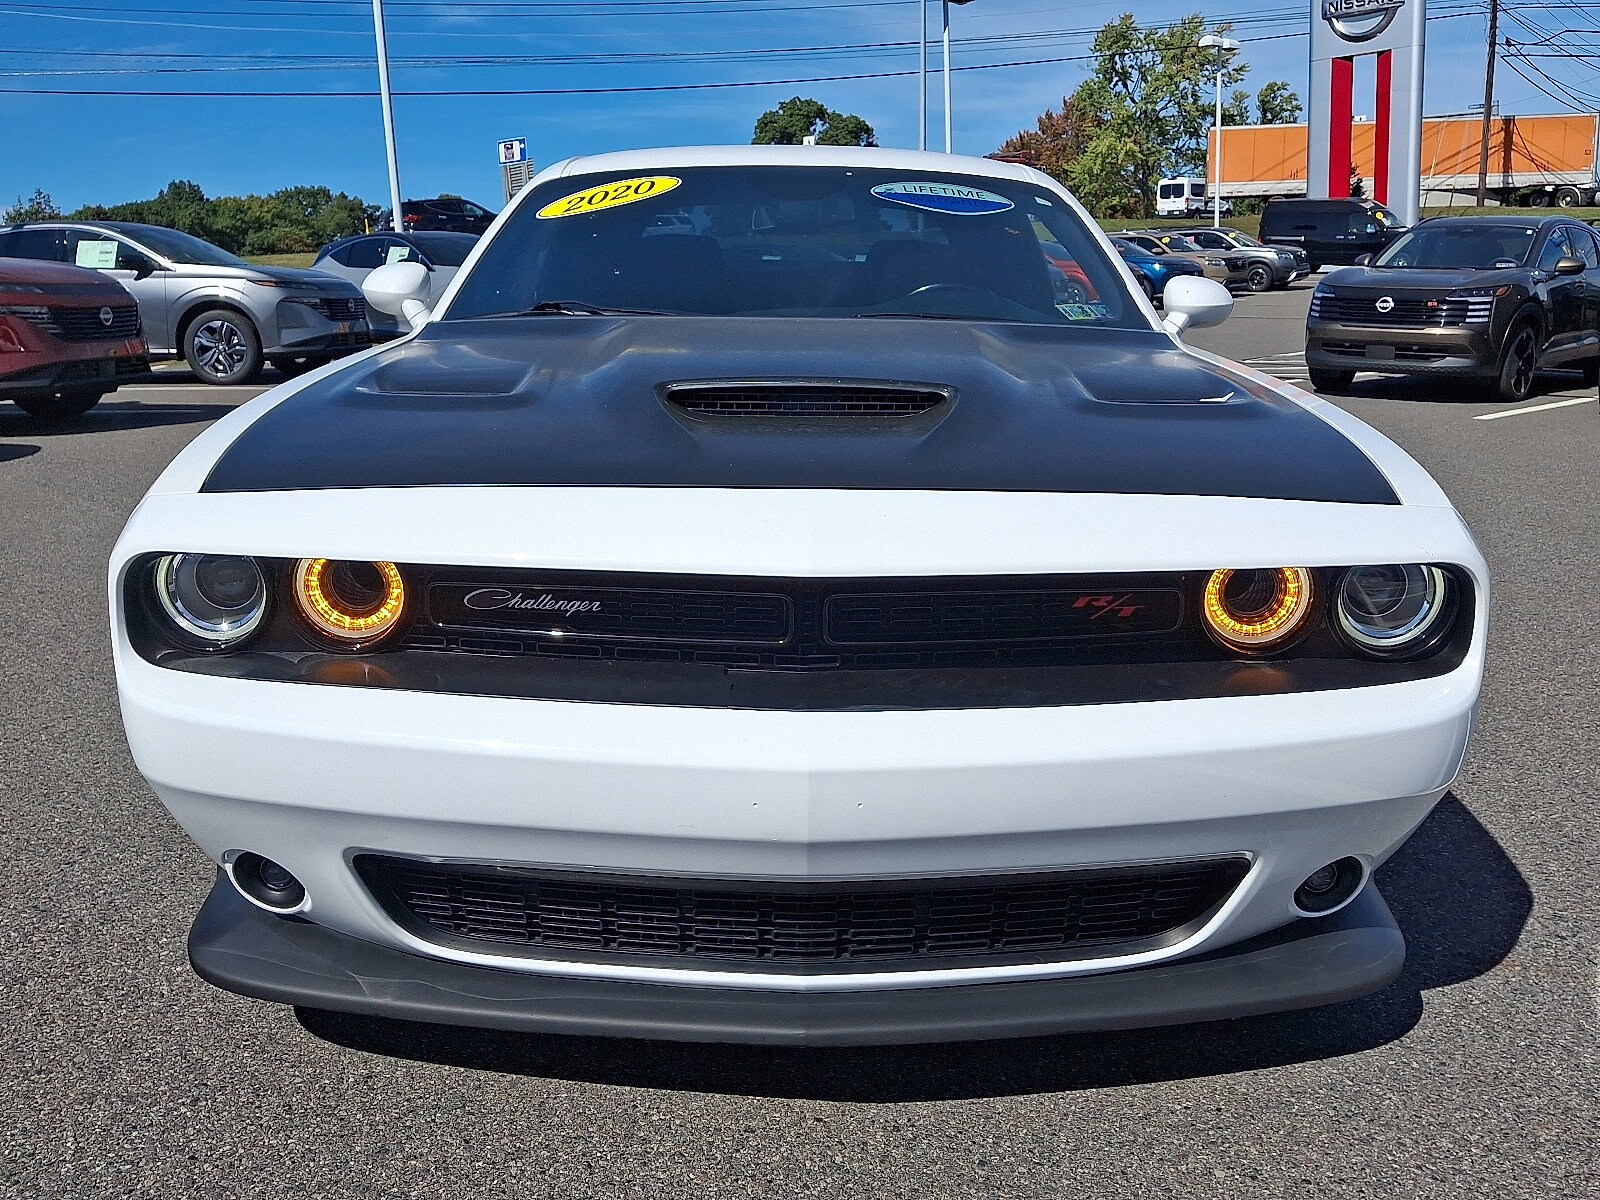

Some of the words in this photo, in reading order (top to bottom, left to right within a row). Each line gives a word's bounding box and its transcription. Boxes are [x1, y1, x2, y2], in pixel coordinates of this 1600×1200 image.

[1328, 0, 1393, 13] NISS
[563, 180, 656, 214] 2020
[903, 184, 986, 199] LIFETIME
[463, 588, 602, 617] Challenger
[1071, 593, 1145, 620] R/T
